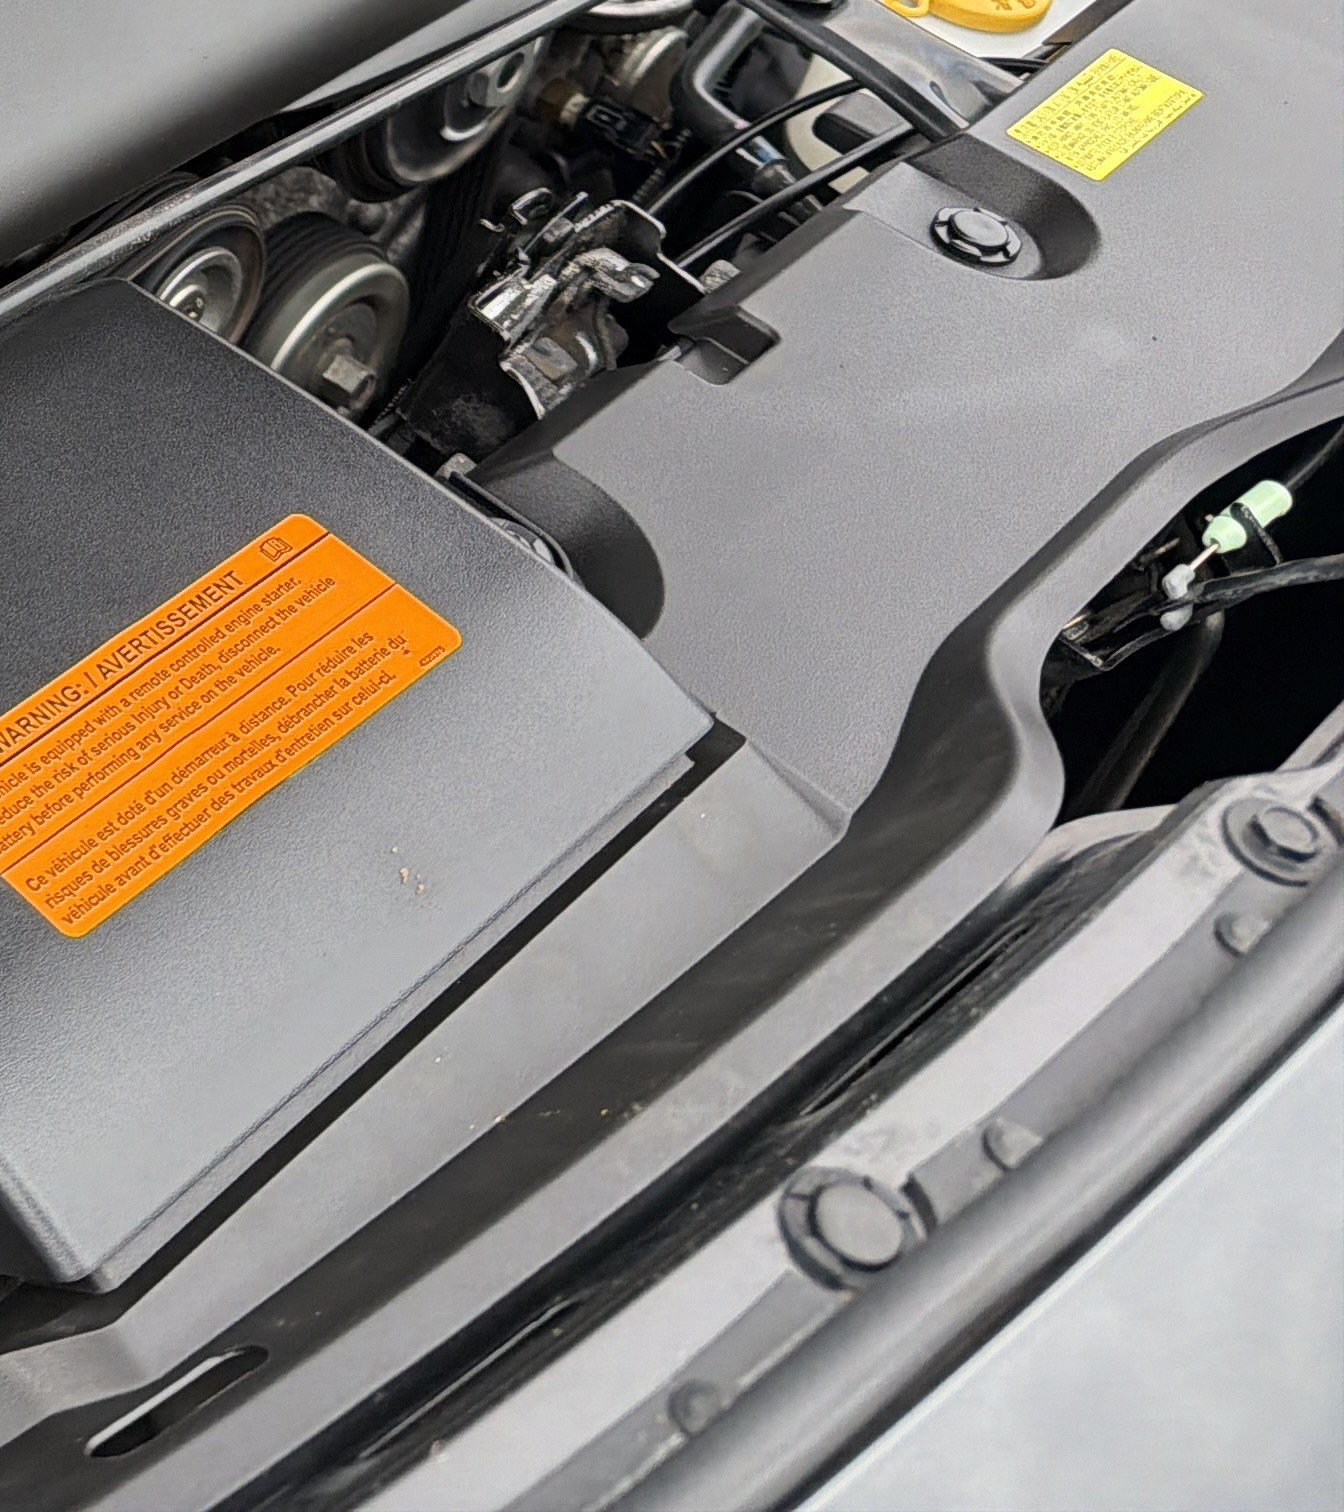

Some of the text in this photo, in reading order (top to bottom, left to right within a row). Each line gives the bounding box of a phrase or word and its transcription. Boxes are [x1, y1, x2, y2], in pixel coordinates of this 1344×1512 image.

[21, 760, 42, 775] is
[38, 718, 98, 765] equipped
[91, 703, 123, 726] with
[118, 696, 132, 708] a
[127, 667, 172, 702] remote
[167, 626, 228, 673] controlled
[222, 602, 264, 633] engine
[259, 576, 303, 607] starter.
[28, 778, 56, 799] the
[50, 760, 81, 784] risk
[75, 747, 94, 766] of
[89, 720, 137, 757] serious
[166, 684, 184, 700] or
[176, 662, 223, 691] Death,
[216, 614, 282, 664] disconnect
[273, 603, 299, 622] the
[293, 576, 336, 607] vehicle
[28, 792, 75, 826] before
[70, 745, 142, 800] performing
[134, 727, 162, 751] any
[157, 699, 203, 733] service
[198, 687, 220, 704] on
[212, 673, 238, 693] the
[232, 644, 282, 678] vehicle.
[94, 568, 244, 682] AVERTISSEMENT
[23, 630, 375, 892] Ce véhicule est doté d'un démarreur à distance. Pour réduire les
[42, 869, 94, 910] risques
[89, 856, 112, 874] de
[103, 813, 169, 862] blessures
[164, 781, 209, 821] graves
[205, 767, 227, 786] ou
[221, 732, 282, 774] mortelles,
[275, 683, 339, 734] débrancher
[330, 675, 352, 690] la
[343, 645, 392, 681] batterie
[386, 633, 408, 650] du
[59, 668, 397, 925] véhicule avant d'effectuer des travaux d'entretien sur celui-ci.
